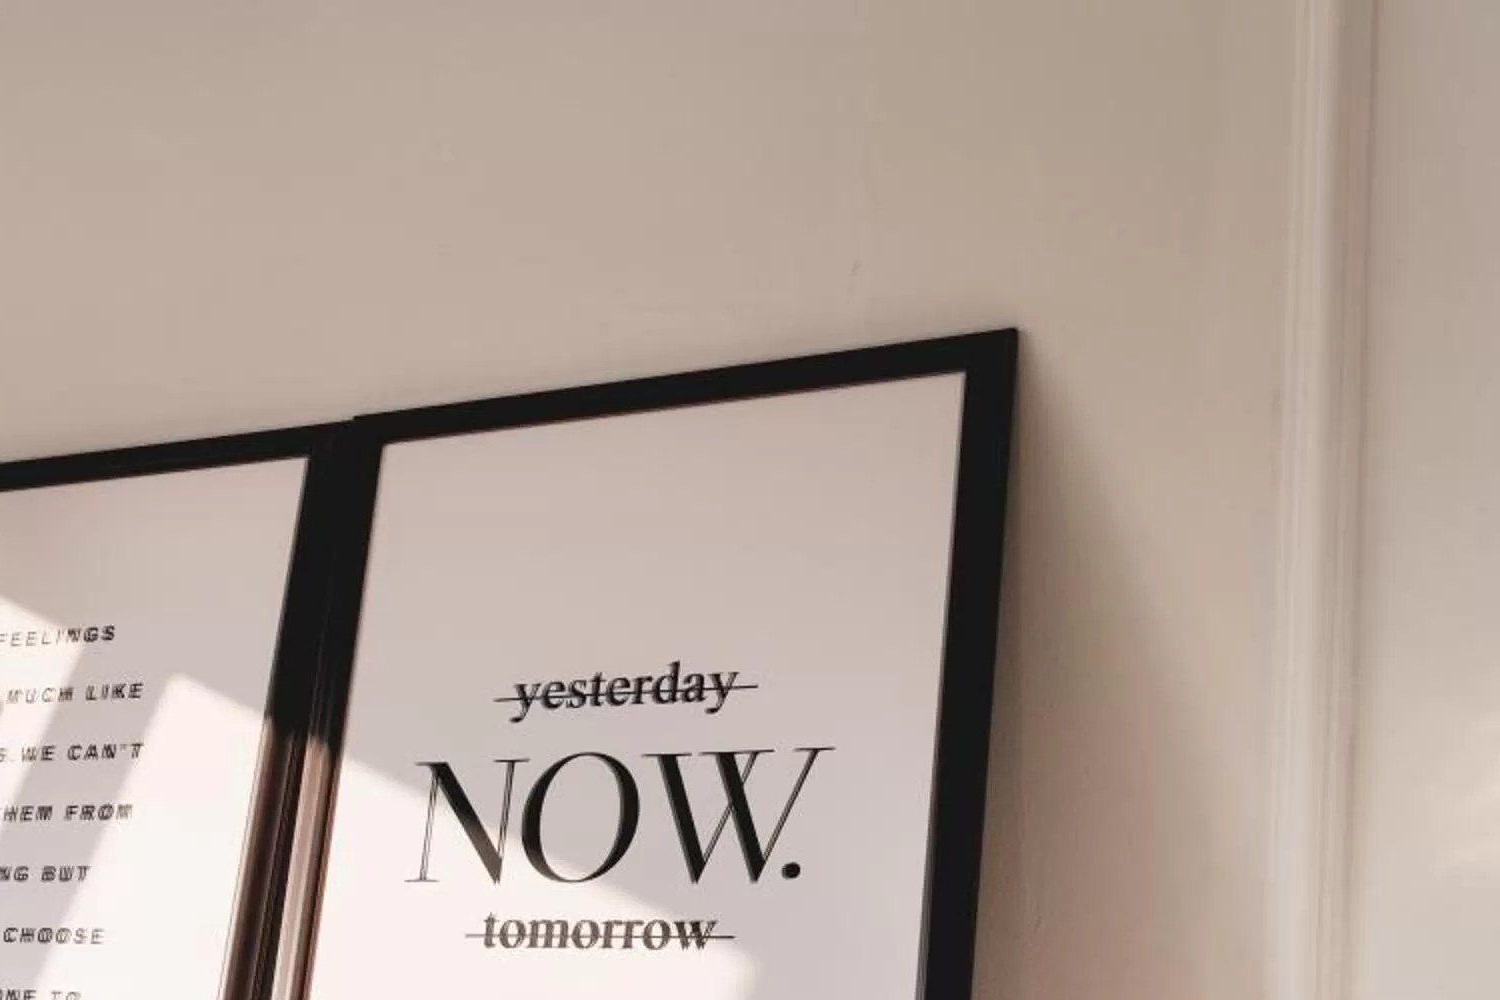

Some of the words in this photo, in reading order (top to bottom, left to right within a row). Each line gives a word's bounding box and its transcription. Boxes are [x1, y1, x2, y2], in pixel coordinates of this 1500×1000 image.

[8, 686, 74, 704] MUCH
[86, 682, 144, 700] LIKE
[509, 660, 741, 723] yesterday
[21, 745, 55, 762] WE
[67, 743, 145, 761] CAN'T
[65, 803, 133, 821] FROM
[404, 747, 836, 884] NOW.
[41, 865, 91, 882] BUT
[2, 926, 105, 944] CHOOSE
[483, 913, 717, 951] tomorrow
